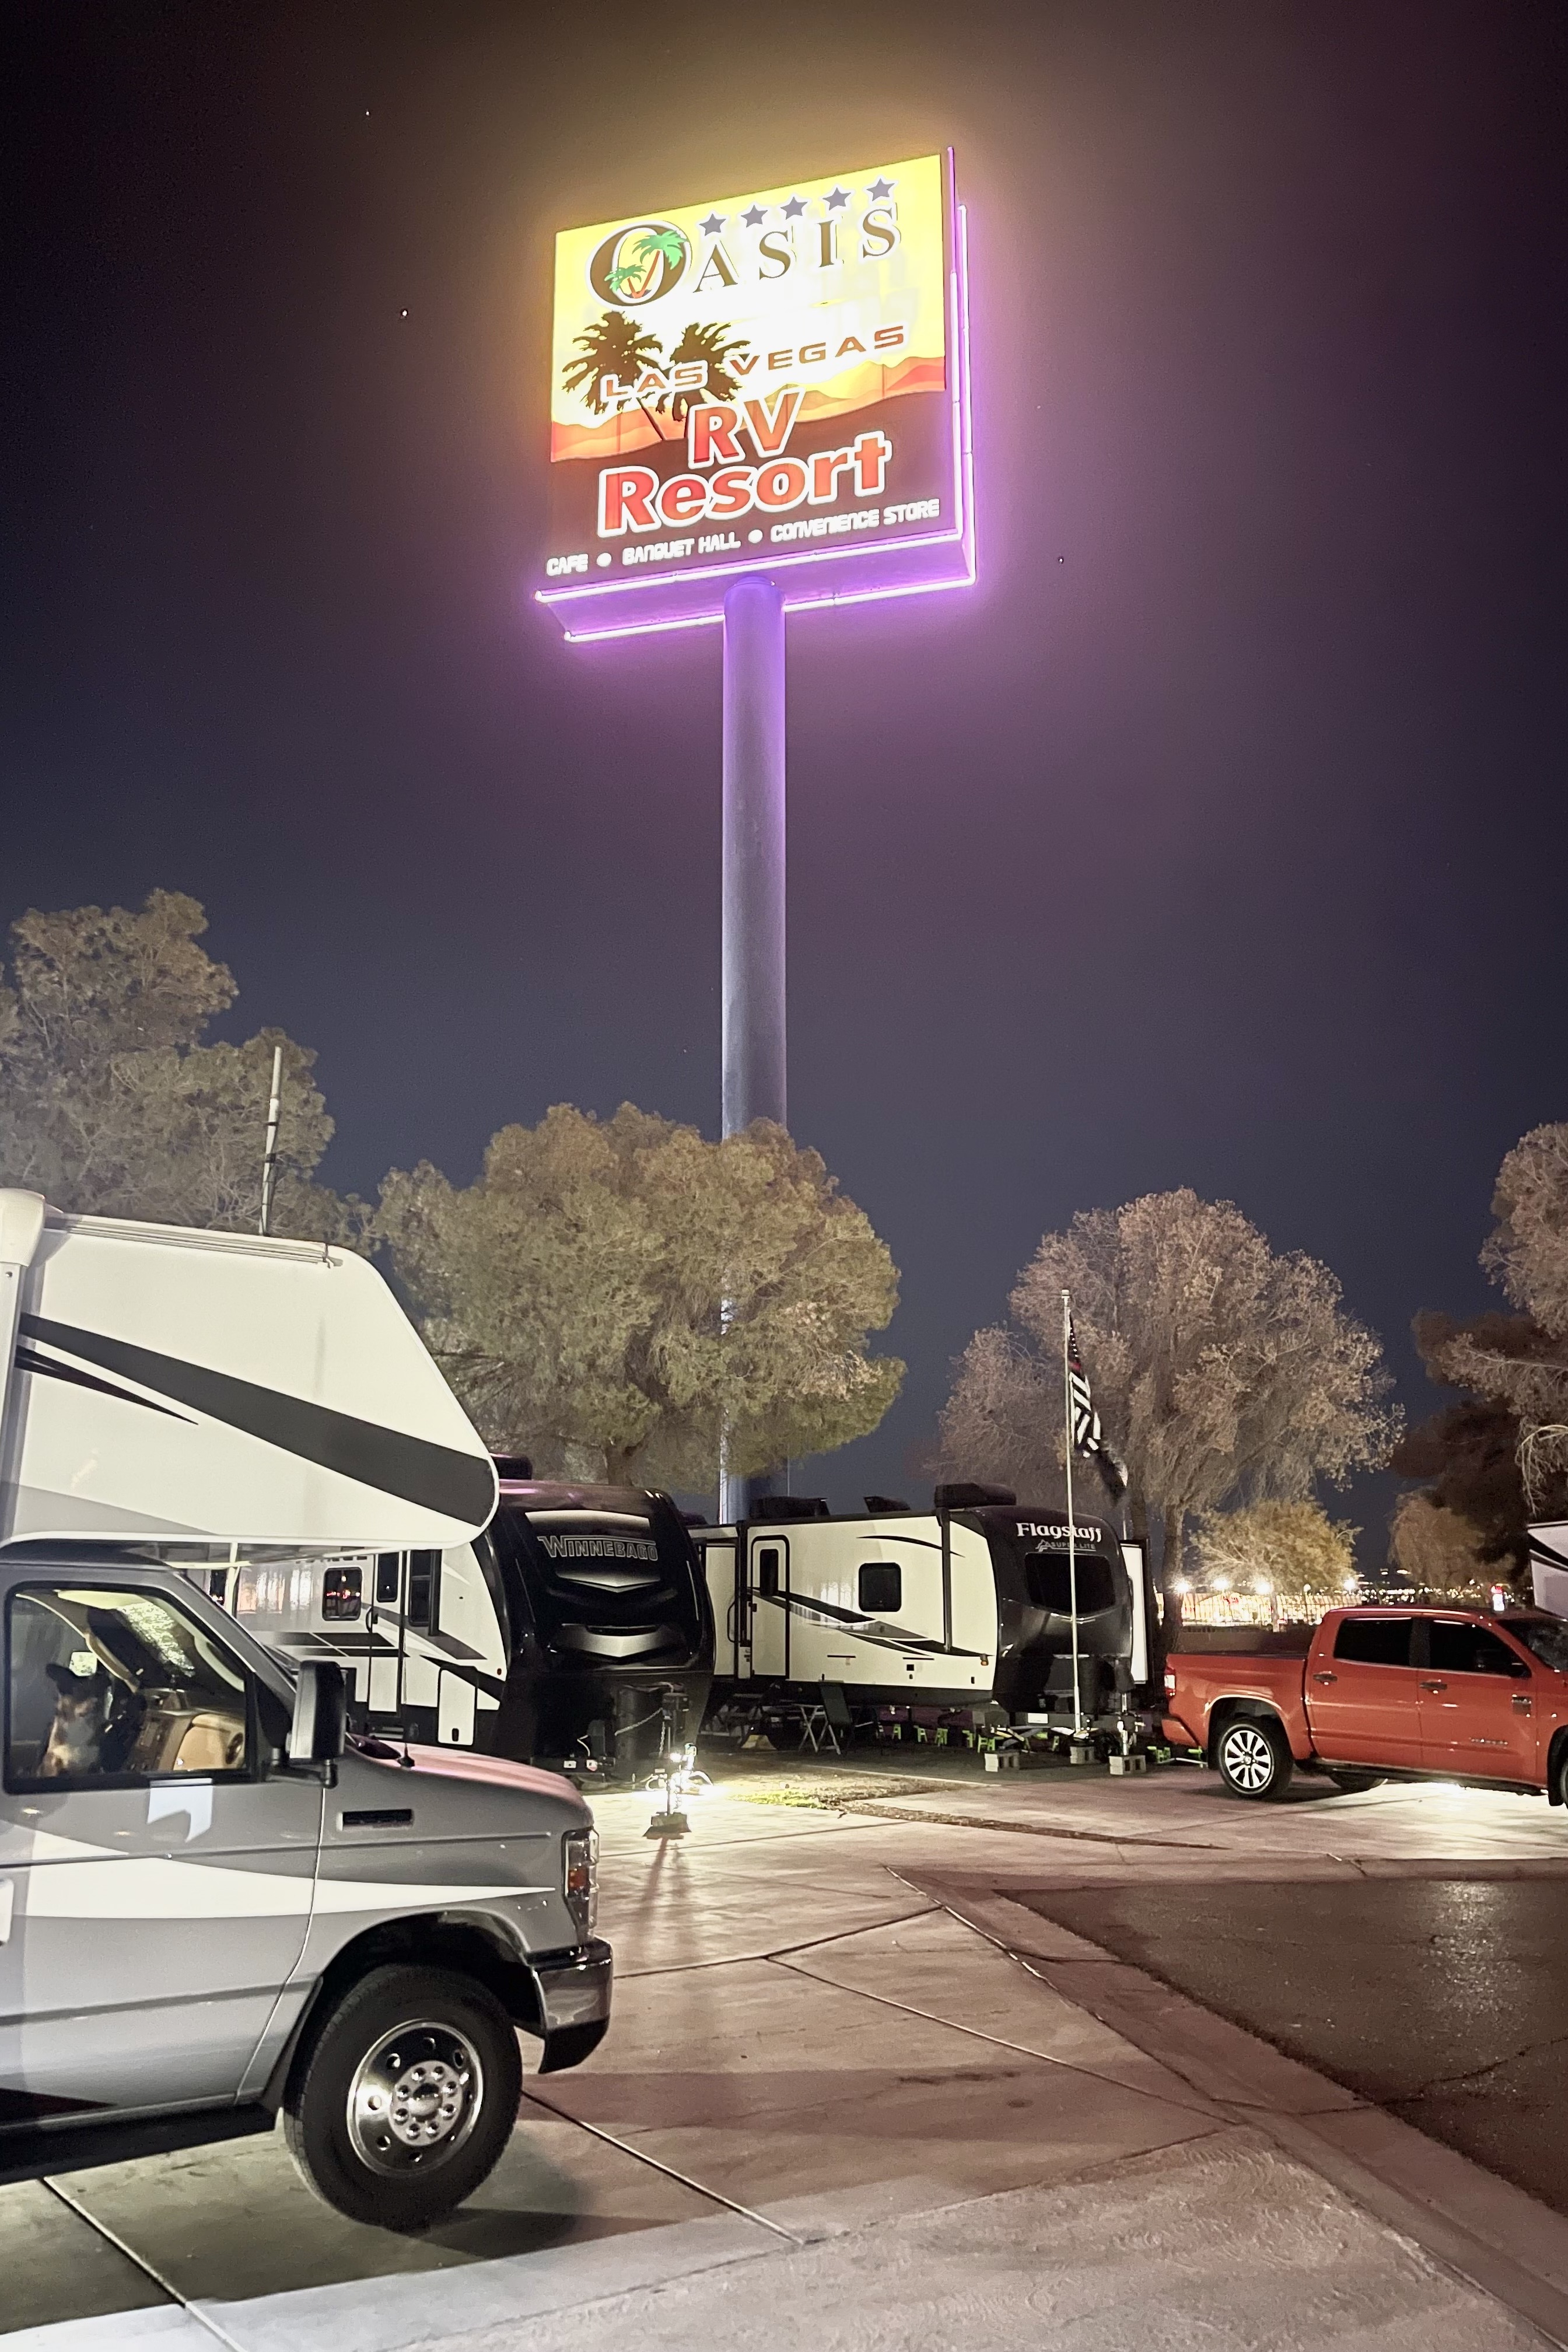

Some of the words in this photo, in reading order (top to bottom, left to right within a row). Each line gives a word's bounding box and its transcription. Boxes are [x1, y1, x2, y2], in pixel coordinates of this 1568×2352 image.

[589, 203, 901, 307] OASIS
[603, 363, 705, 399] LAS
[729, 324, 904, 377] VEGAS
[688, 387, 806, 470] RV
[598, 432, 892, 538] Resort
[547, 554, 588, 576] CAFE
[622, 538, 695, 565] BANQUET
[698, 532, 741, 554] HALL
[771, 509, 880, 542] CONVENIENCE
[883, 499, 940, 524] STORE
[537, 1535, 659, 1561] WINNEBAGO
[1016, 1522, 1101, 1542] Flagstaff
